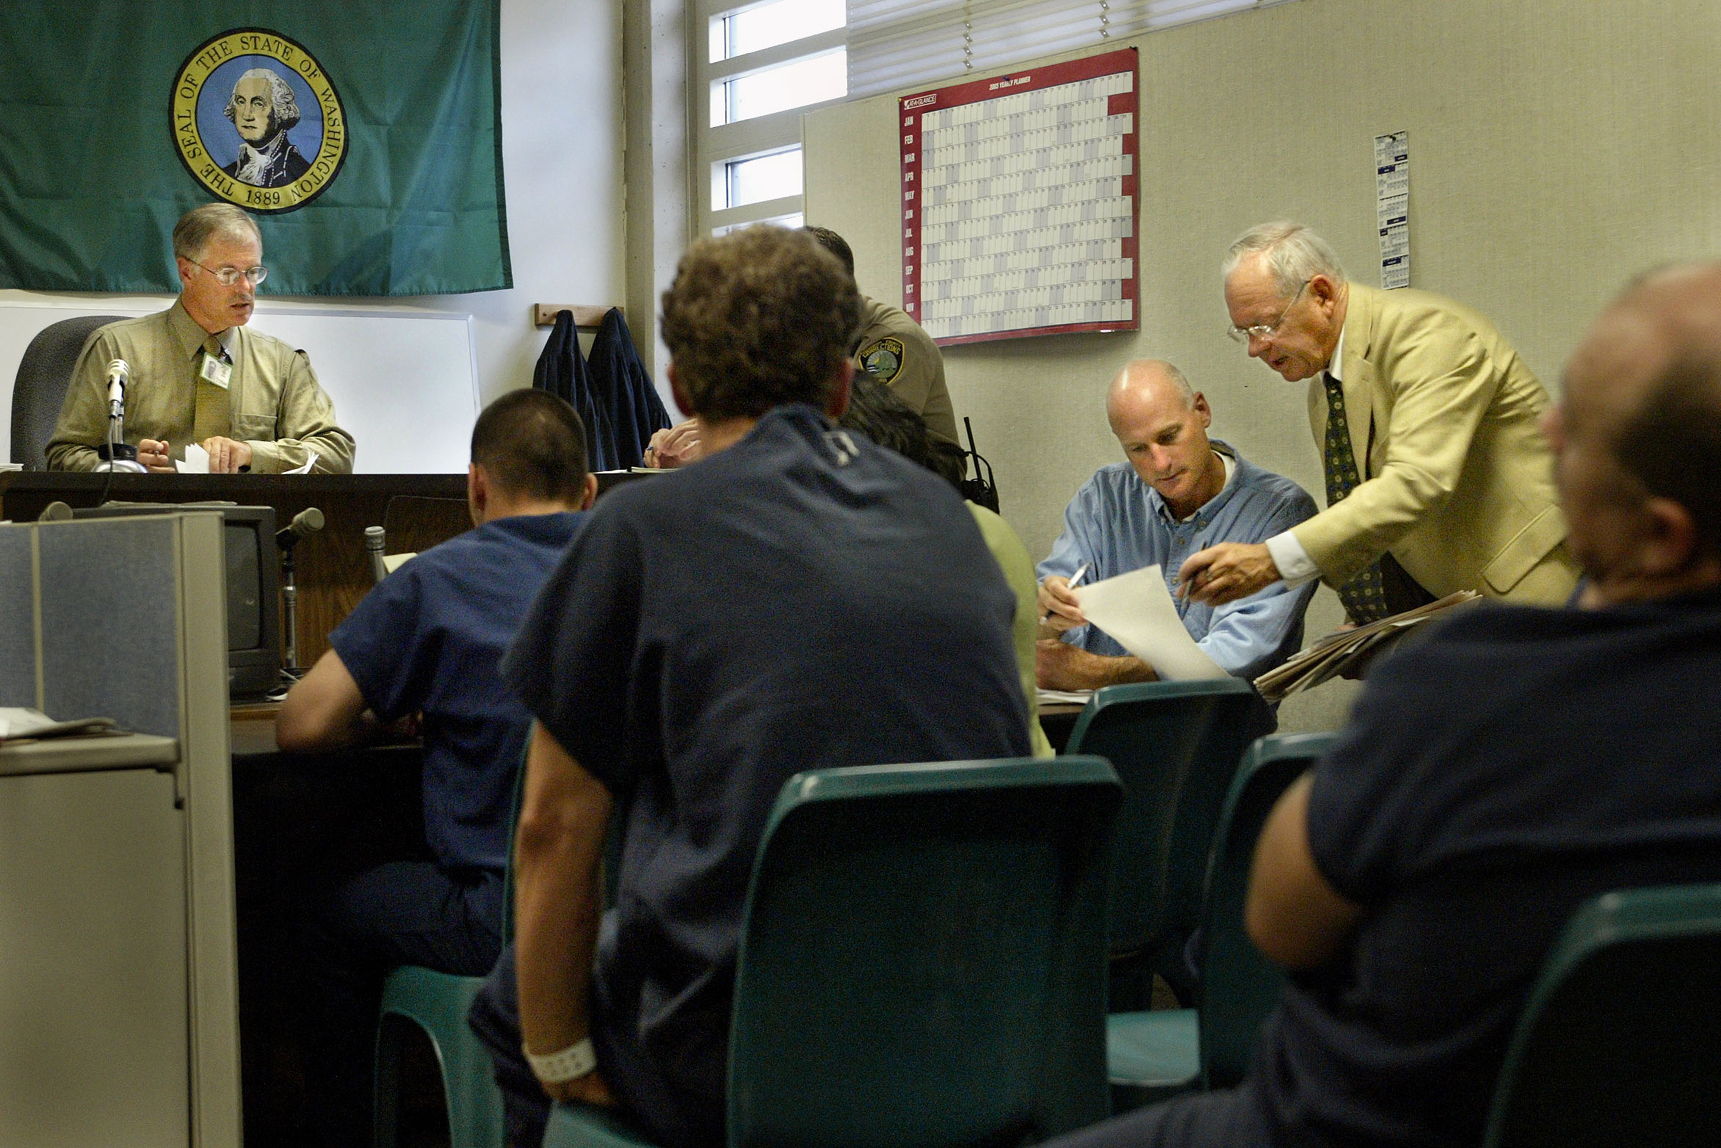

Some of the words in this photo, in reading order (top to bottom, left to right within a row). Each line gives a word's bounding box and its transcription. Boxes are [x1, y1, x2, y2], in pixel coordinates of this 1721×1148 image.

[196, 41, 233, 71] THE
[240, 36, 293, 61] STATE
[300, 59, 321, 79] OF
[180, 73, 198, 98] OF
[178, 109, 202, 159] SEAL
[291, 88, 341, 202] WASHINGTON
[200, 164, 235, 196] THE
[246, 190, 281, 205] 1889
